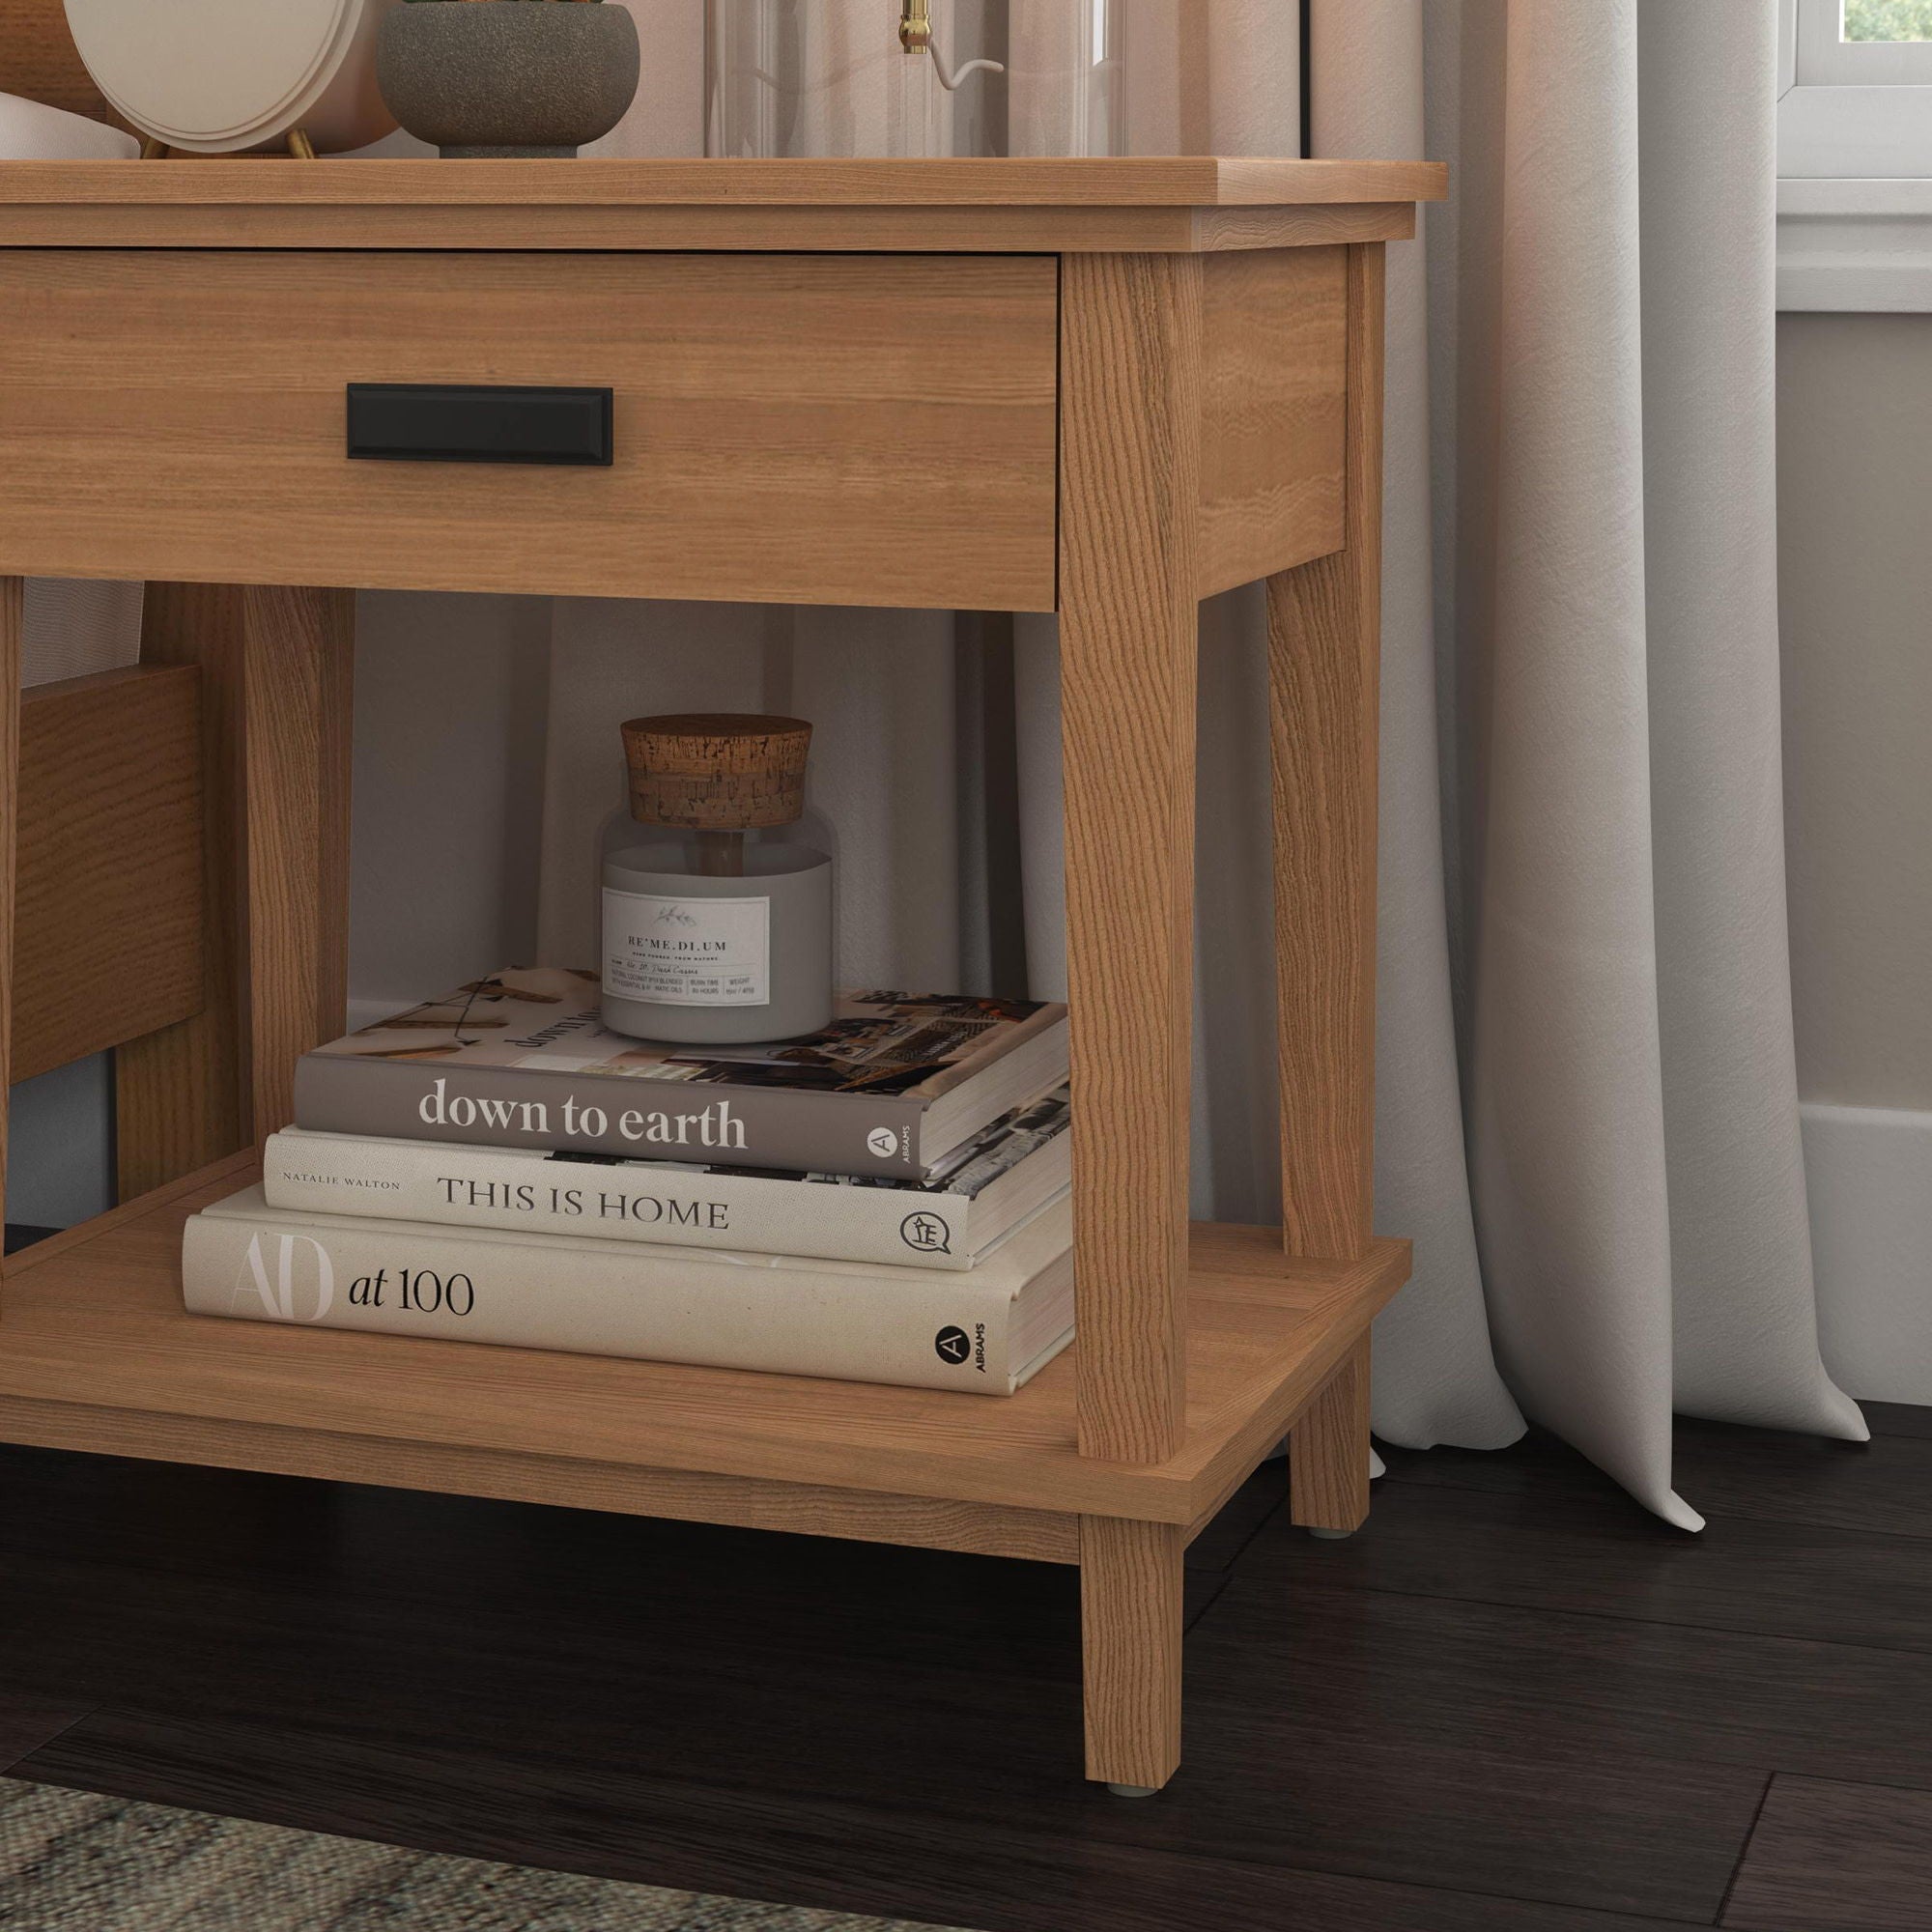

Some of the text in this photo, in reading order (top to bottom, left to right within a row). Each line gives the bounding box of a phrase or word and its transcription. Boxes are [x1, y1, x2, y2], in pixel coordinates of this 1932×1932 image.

[502, 1021, 587, 1048] down
[419, 1078, 749, 1150] down to earth
[901, 1124, 911, 1165] ABRAMS
[283, 1171, 400, 1190] NATALIE WALTON
[437, 1178, 730, 1230] THIS IS HOME
[230, 1232, 474, 1322] AD at 100
[975, 1321, 986, 1374] ABRAMS
